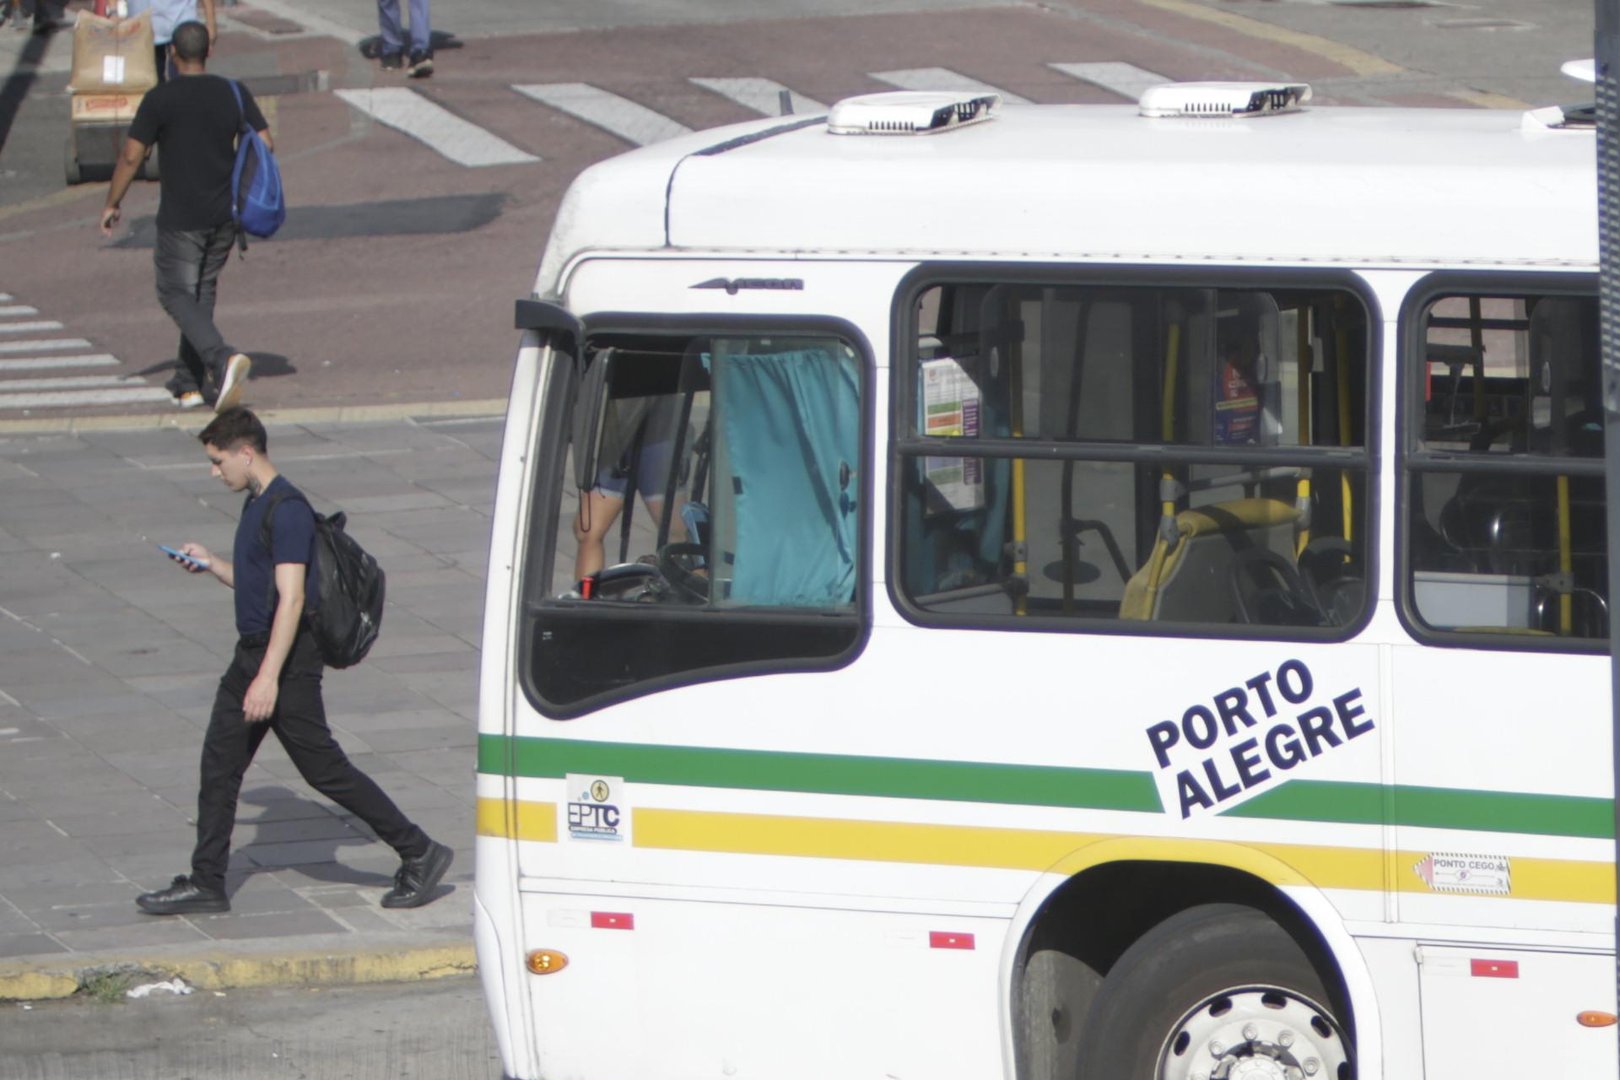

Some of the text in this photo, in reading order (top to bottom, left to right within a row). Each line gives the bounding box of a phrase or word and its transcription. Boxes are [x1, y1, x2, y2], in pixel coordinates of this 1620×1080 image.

[1146, 659, 1314, 769] PORTO
[1176, 687, 1376, 820] ALEGRE
[568, 802, 620, 828] EPTC
[1434, 859, 1495, 870] PONTO CEGO
